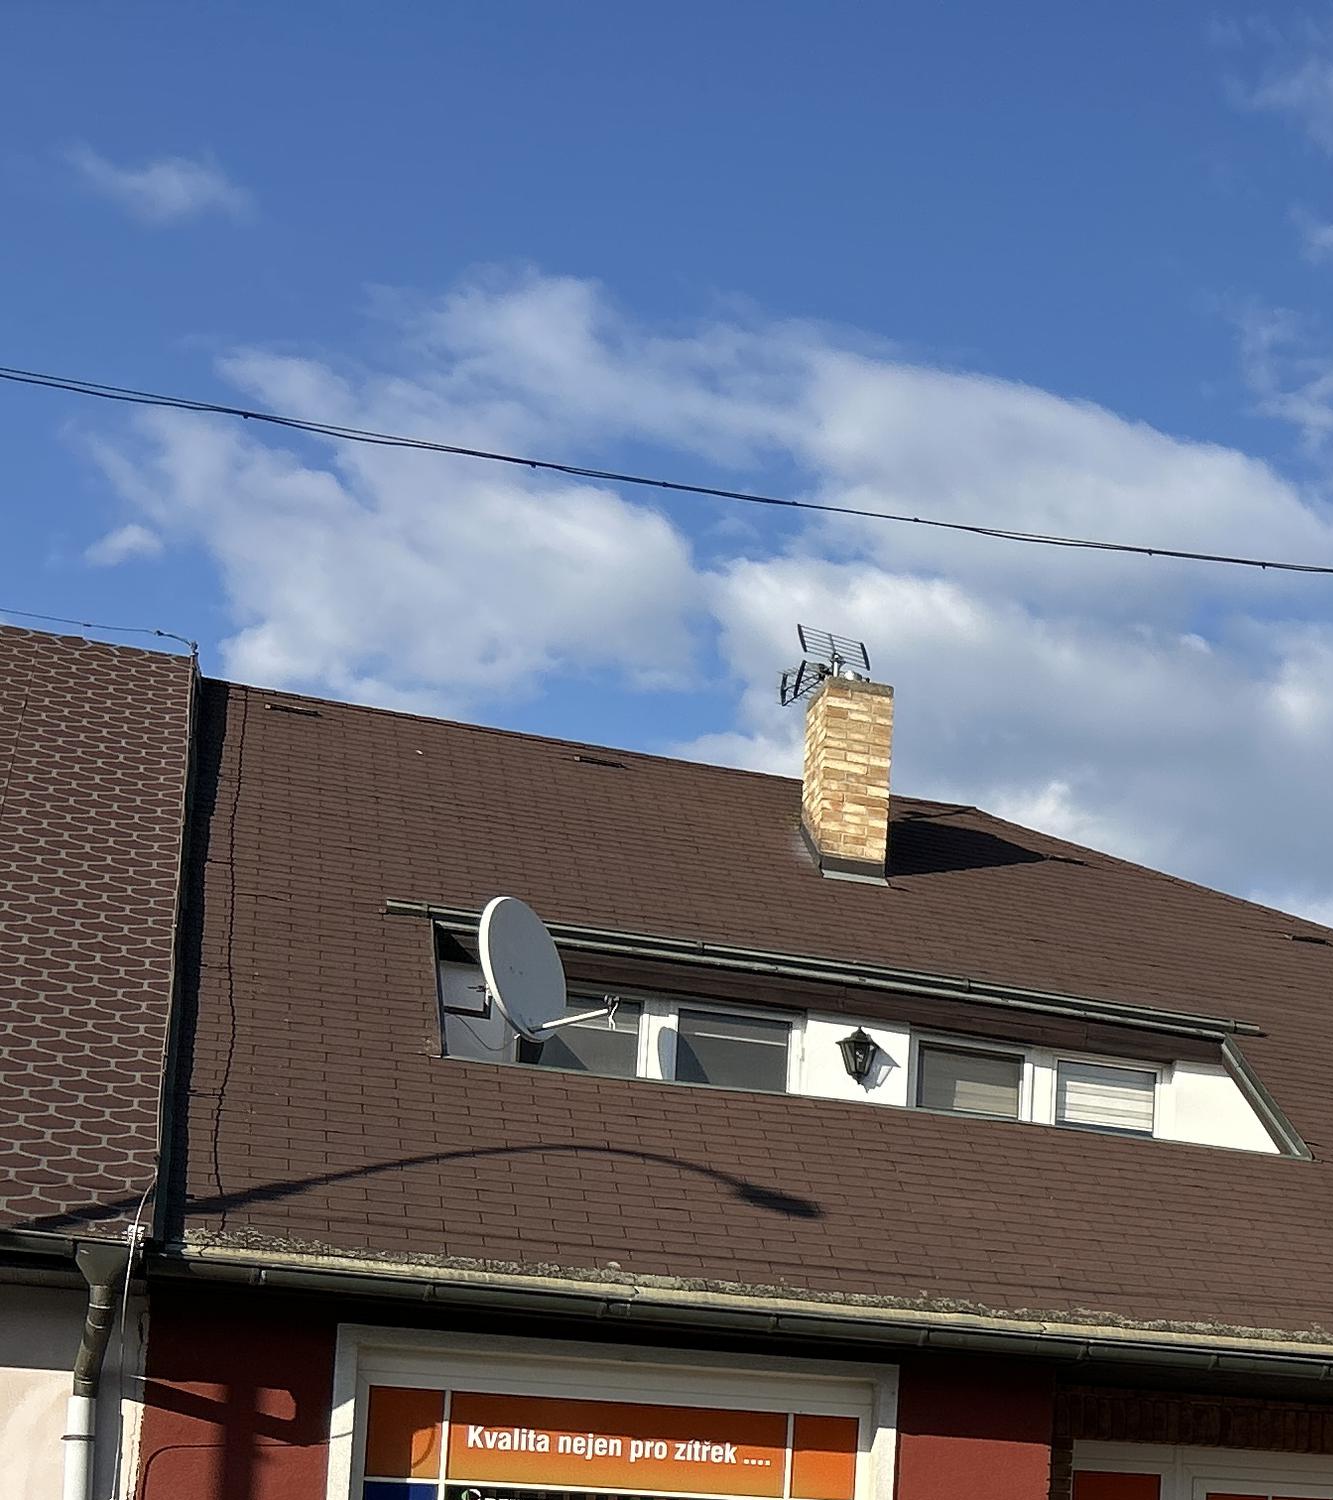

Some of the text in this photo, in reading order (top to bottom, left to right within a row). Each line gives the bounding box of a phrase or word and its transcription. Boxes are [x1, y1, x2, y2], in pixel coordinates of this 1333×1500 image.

[467, 1424, 550, 1453] Kvalita
[558, 1434, 622, 1461] nejen
[629, 1438, 668, 1463] pro
[674, 1439, 737, 1464] zítřek
